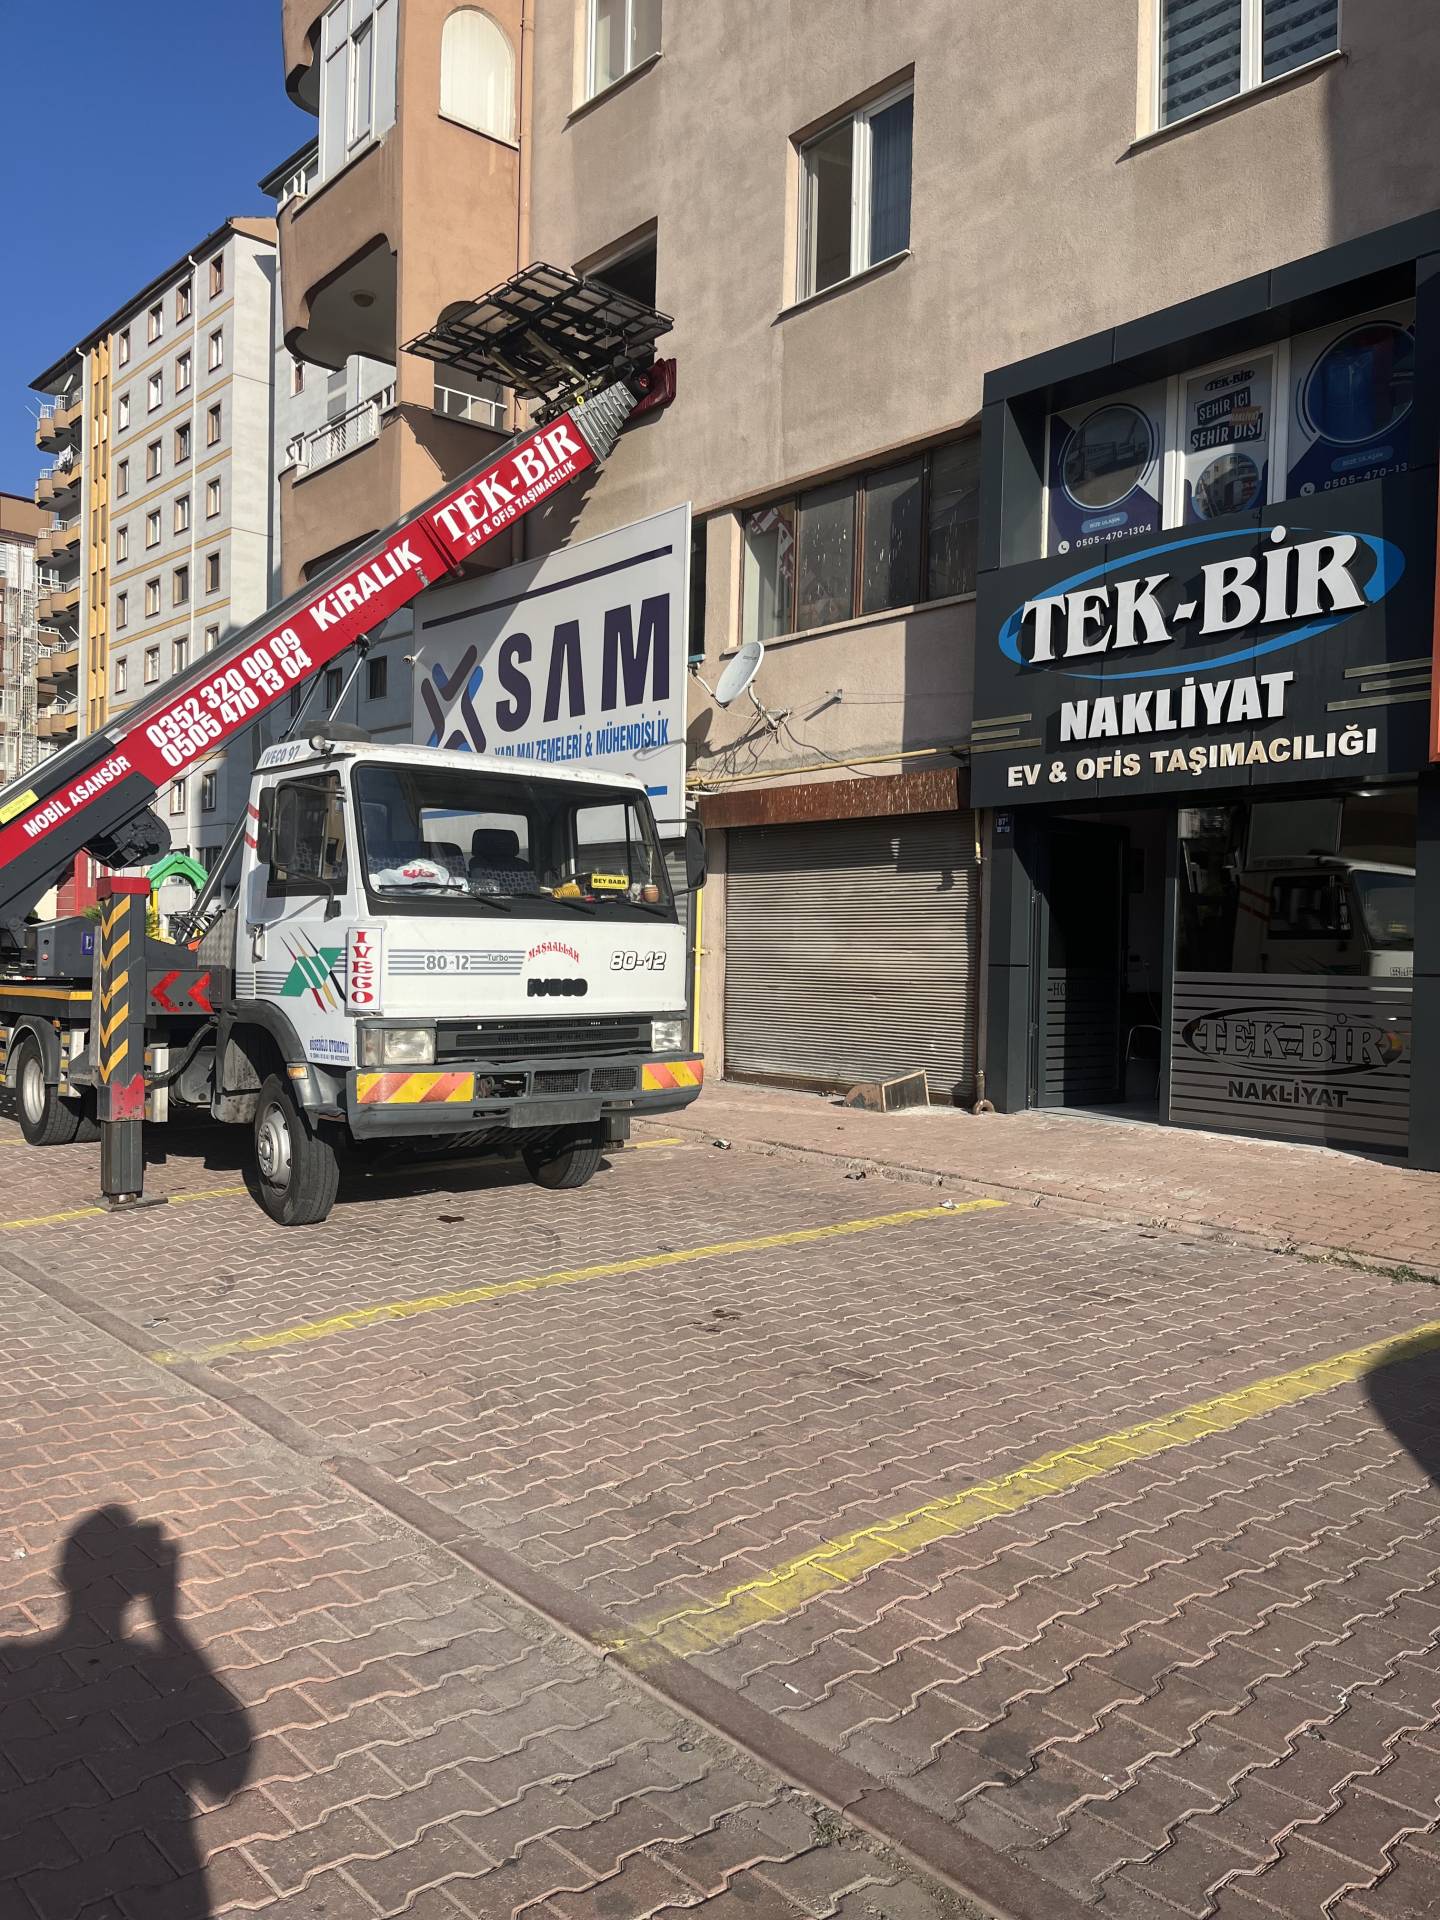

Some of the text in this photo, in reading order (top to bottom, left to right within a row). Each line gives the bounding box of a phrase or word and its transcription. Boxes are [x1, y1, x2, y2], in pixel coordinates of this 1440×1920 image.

[1192, 426, 1229, 449] ŞEHİR
[433, 425, 581, 542] TEK-BİR
[466, 460, 576, 546] EV & OFİS TAŞIMACILIK
[1076, 524, 1152, 548] 0505-470-1304
[309, 539, 422, 632] KİRALIK
[1021, 525, 1368, 664] TEK-BİR
[146, 628, 301, 748] 0352 320 00 09
[161, 647, 312, 767] 0505 470 13 04
[1060, 671, 1294, 742] NAKLİYAT
[262, 748, 287, 766] IVECO
[585, 731, 593, 757] &
[596, 711, 670, 755] MÜHENDİSLİK
[1007, 724, 1377, 788] EV & OFİS TAŞIMACILIĞI
[22, 800, 71, 837] MOBİL
[68, 755, 132, 807] ASANSÖR
[425, 953, 509, 971] 80-12 Turbo
[610, 951, 666, 970] 80-12
[1199, 1013, 1388, 1066] TEK-BİR
[1228, 1080, 1348, 1108] NAKLİYAT
